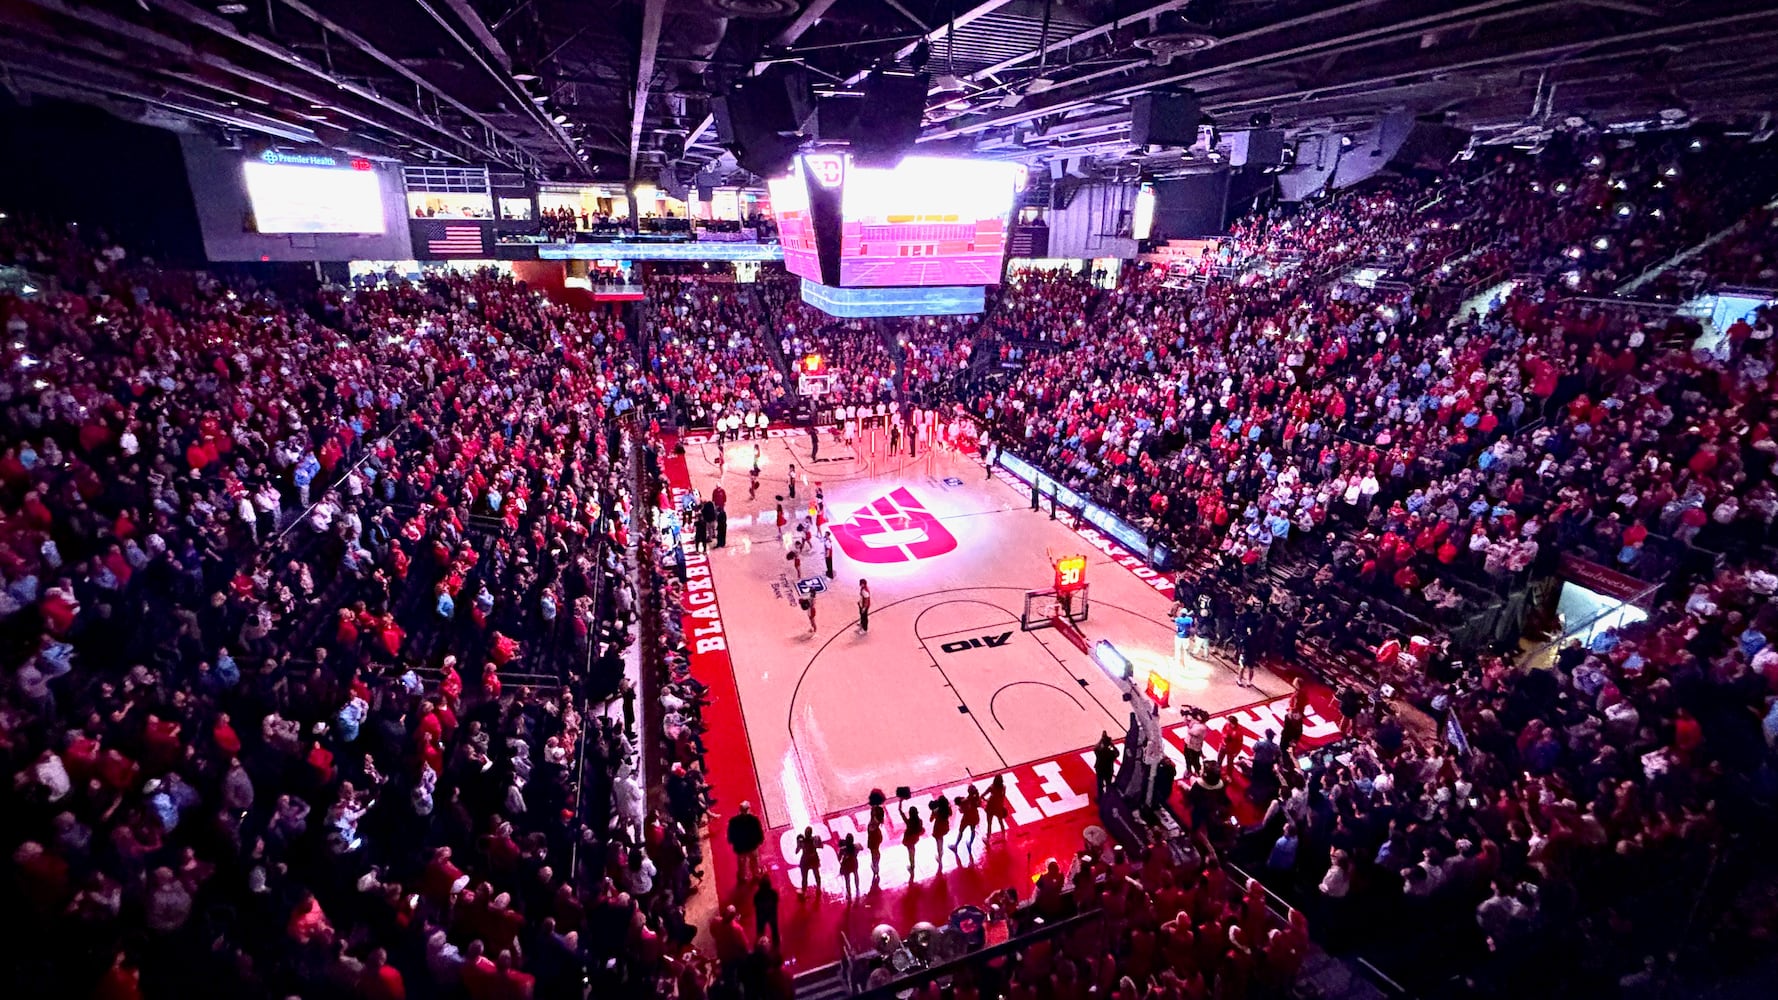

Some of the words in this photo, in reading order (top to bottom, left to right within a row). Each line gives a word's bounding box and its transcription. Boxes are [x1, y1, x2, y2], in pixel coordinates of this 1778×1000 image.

[279, 154, 310, 164] Premier
[310, 156, 336, 166] Health
[1060, 568, 1080, 586] 30
[941, 631, 1014, 653] A10
